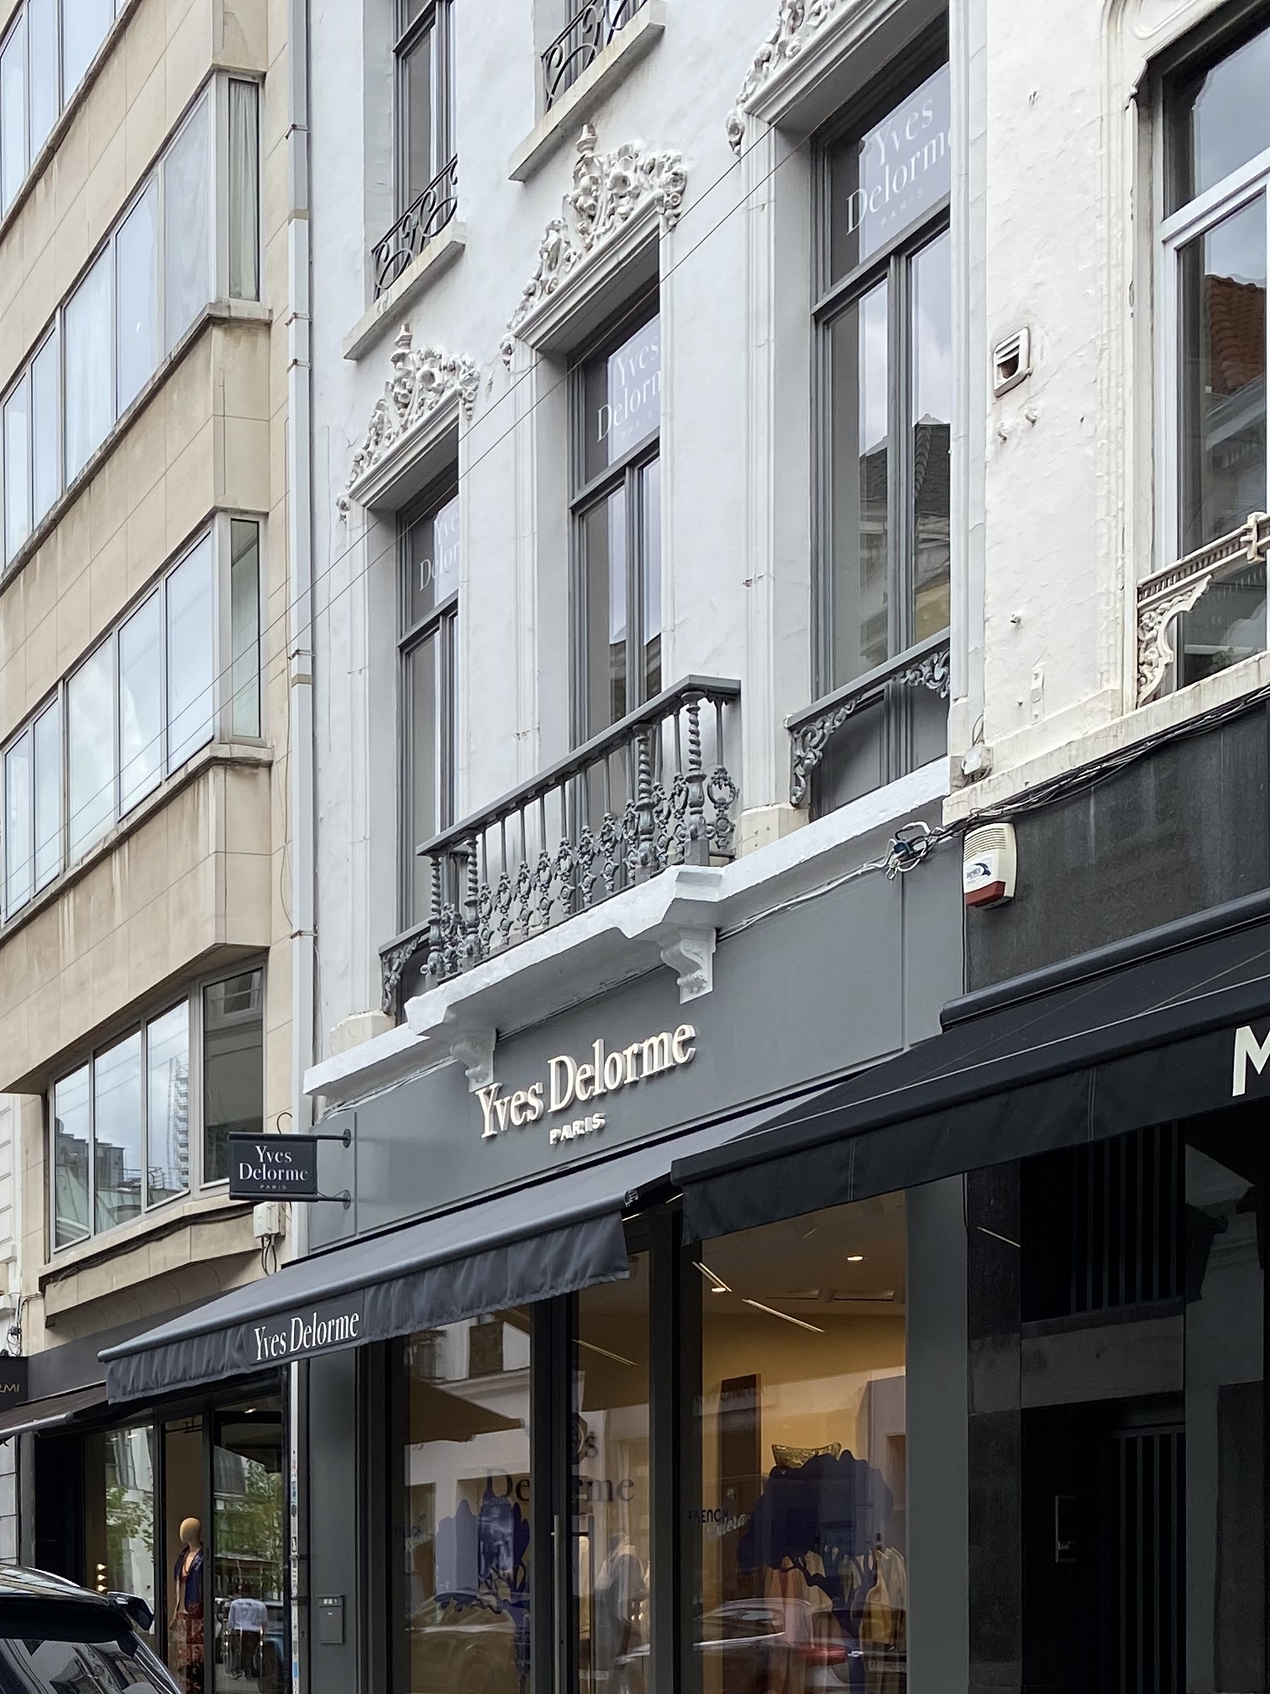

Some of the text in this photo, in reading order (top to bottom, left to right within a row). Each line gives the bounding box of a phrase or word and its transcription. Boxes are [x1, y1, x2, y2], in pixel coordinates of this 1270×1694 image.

[869, 98, 934, 168] Yves
[846, 128, 952, 236] Delorm
[880, 186, 924, 229] PARIS
[617, 336, 660, 387] Yves
[597, 370, 661, 443] Delorm
[434, 512, 459, 545] Yve
[419, 540, 460, 592] Delor
[475, 1022, 697, 1139] Yves Delorme
[549, 1112, 607, 1145] PARIS
[238, 1162, 309, 1181] Delorme
[255, 1145, 292, 1163] Yves
[253, 1311, 360, 1361] Yves Delorme
[485, 1467, 635, 1503] Deme
